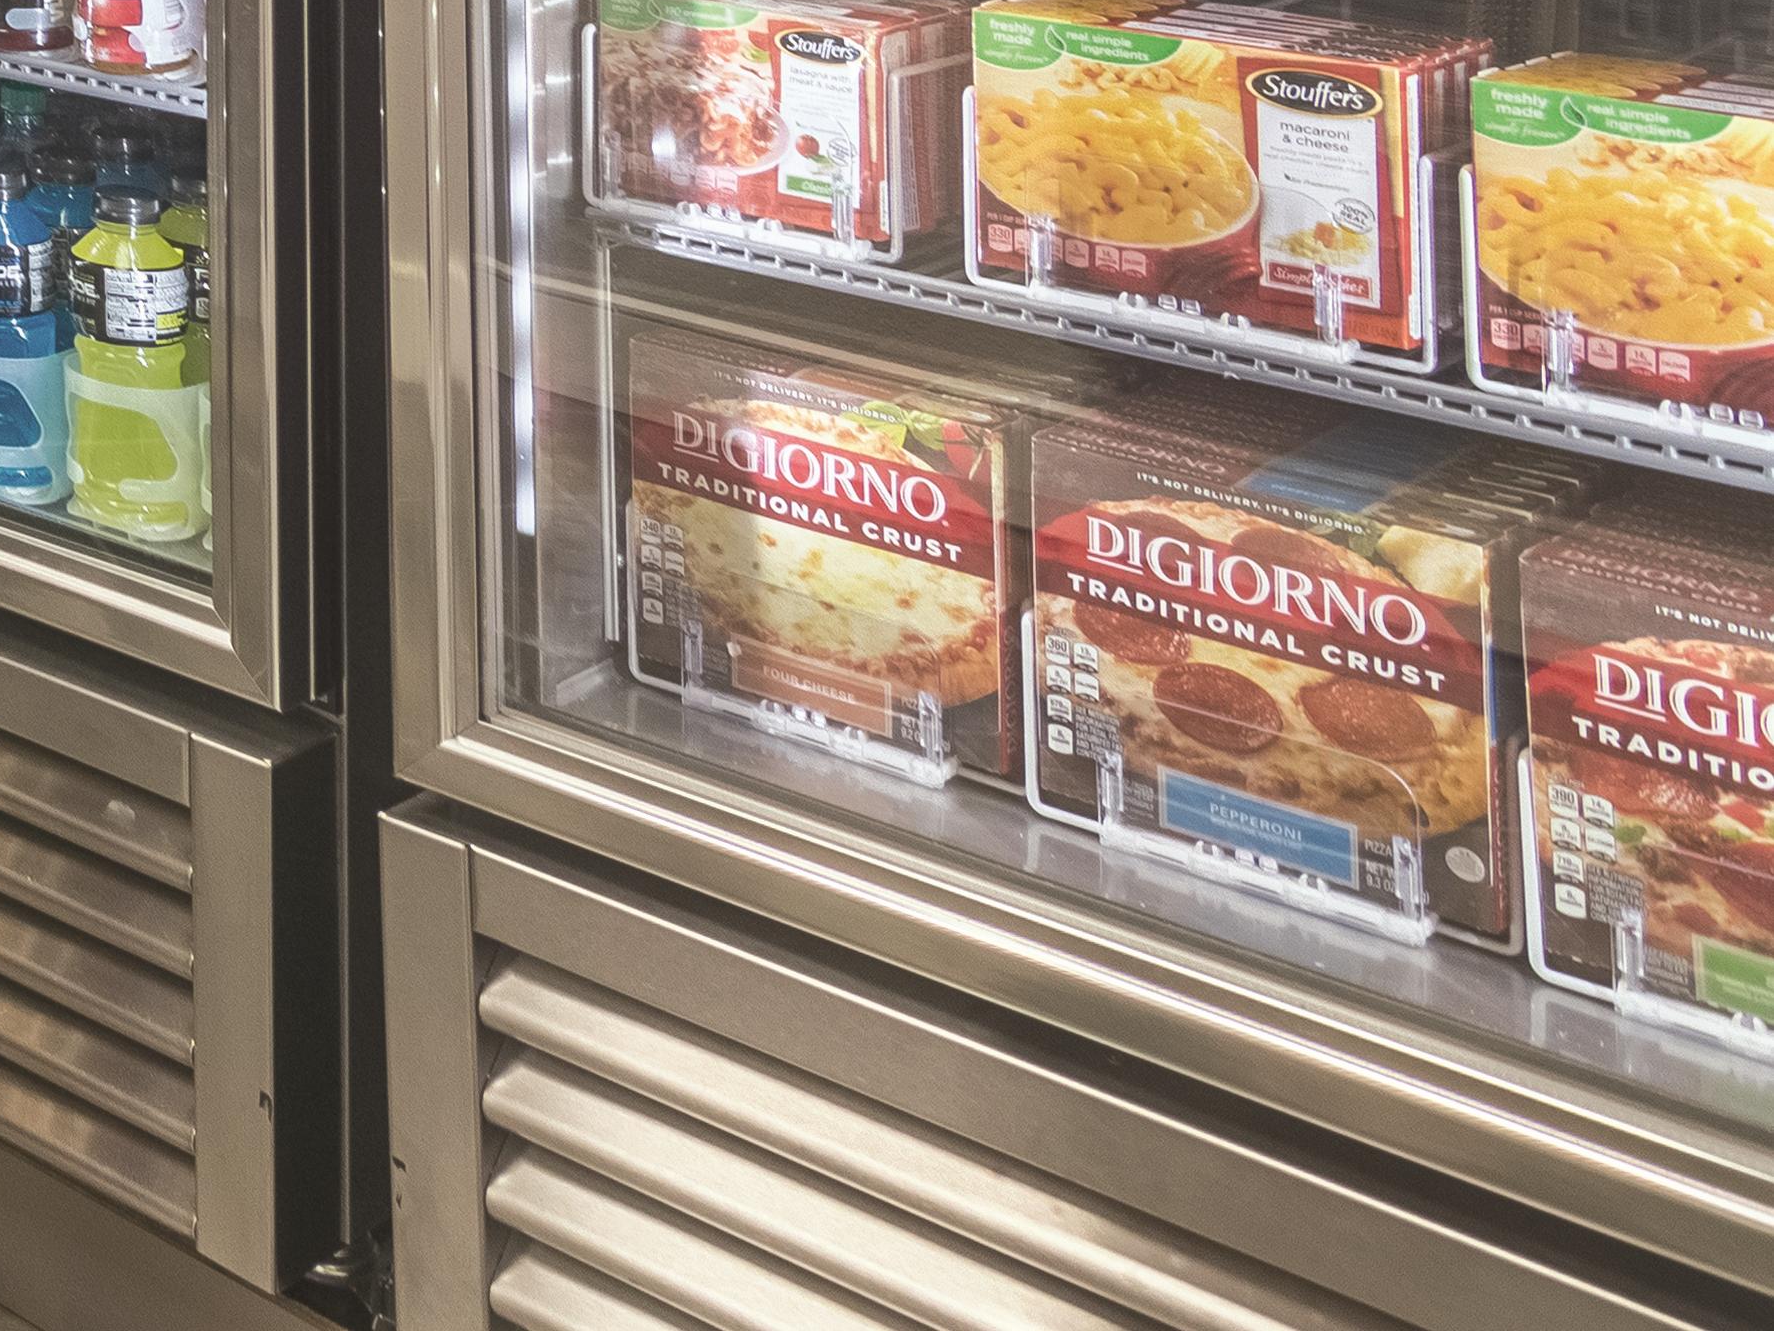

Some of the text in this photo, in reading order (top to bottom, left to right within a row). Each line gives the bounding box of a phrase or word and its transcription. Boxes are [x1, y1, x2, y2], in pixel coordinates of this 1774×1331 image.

[989, 19, 1035, 37] freshly
[993, 31, 1031, 45] made
[785, 34, 861, 62] Stouffer's
[1080, 43, 1149, 62] ingredients
[1263, 74, 1364, 110] Stouffer's
[1490, 89, 1547, 108] freshly
[1496, 105, 1544, 119] made
[1586, 103, 1668, 124] real simple
[1279, 120, 1351, 141] macaroni
[1604, 117, 1691, 140] ingredients
[1493, 321, 1518, 337] 330
[673, 411, 940, 523] DIGIORNO
[658, 462, 963, 562] TRADITIONAL CRUST
[1087, 516, 1426, 646] DIGIORNO
[1655, 605, 1721, 629] IT'S NOT
[1066, 572, 1445, 691] TRADITIONAL CRUST
[1047, 637, 1069, 652] 360
[1551, 788, 1574, 804] 390
[1210, 802, 1303, 842] PEPPERONI
